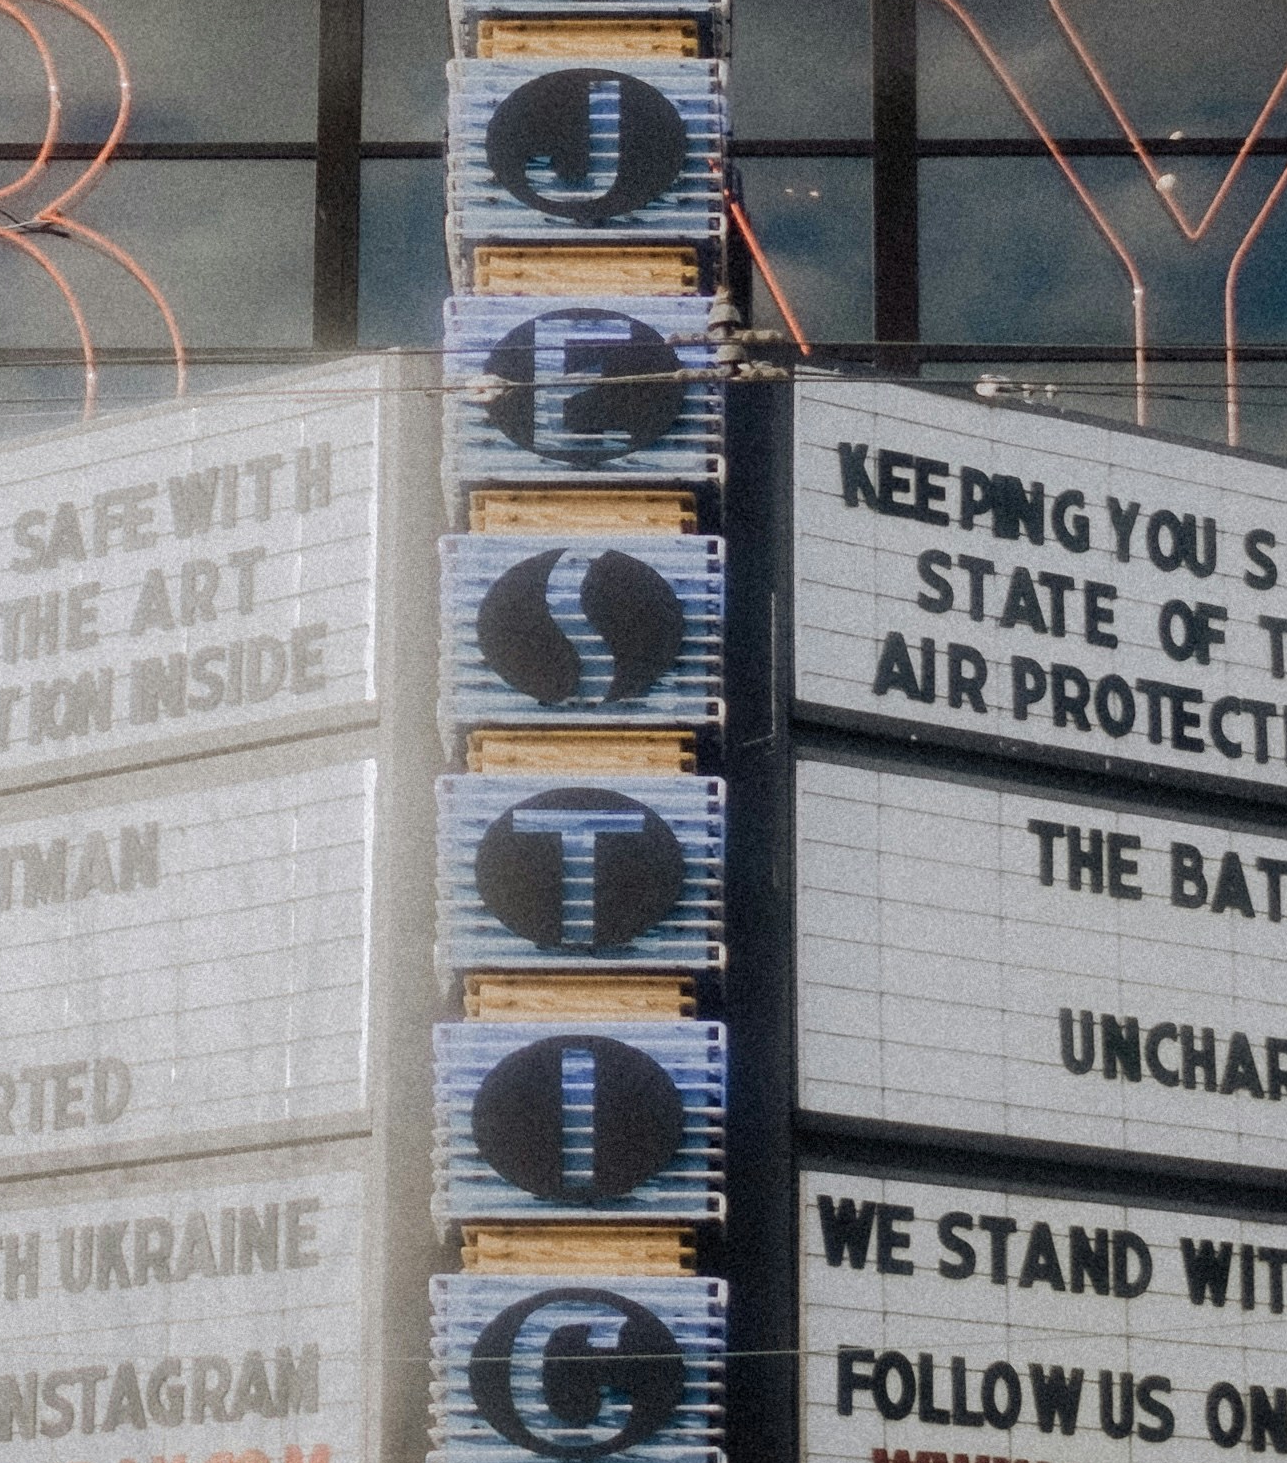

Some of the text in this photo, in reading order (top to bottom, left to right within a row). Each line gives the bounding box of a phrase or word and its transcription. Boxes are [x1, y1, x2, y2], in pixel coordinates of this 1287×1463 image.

[13, 481, 158, 573] SAFE
[168, 442, 332, 539] WITH
[837, 442, 1090, 552] KEEPING
[1107, 496, 1216, 577] YOU
[130, 548, 265, 634] ART
[916, 549, 1118, 649] STATE
[1158, 599, 1227, 664] OF
[128, 621, 327, 725] INSIDE
[872, 633, 988, 713] AIR
[1028, 820, 1141, 902] THE
[59, 1197, 320, 1293] UKRAINE
[817, 1195, 913, 1276] WE
[937, 1212, 1152, 1300] STAND
[836, 1346, 1084, 1436] FOLLOW
[1098, 1371, 1175, 1443] US
